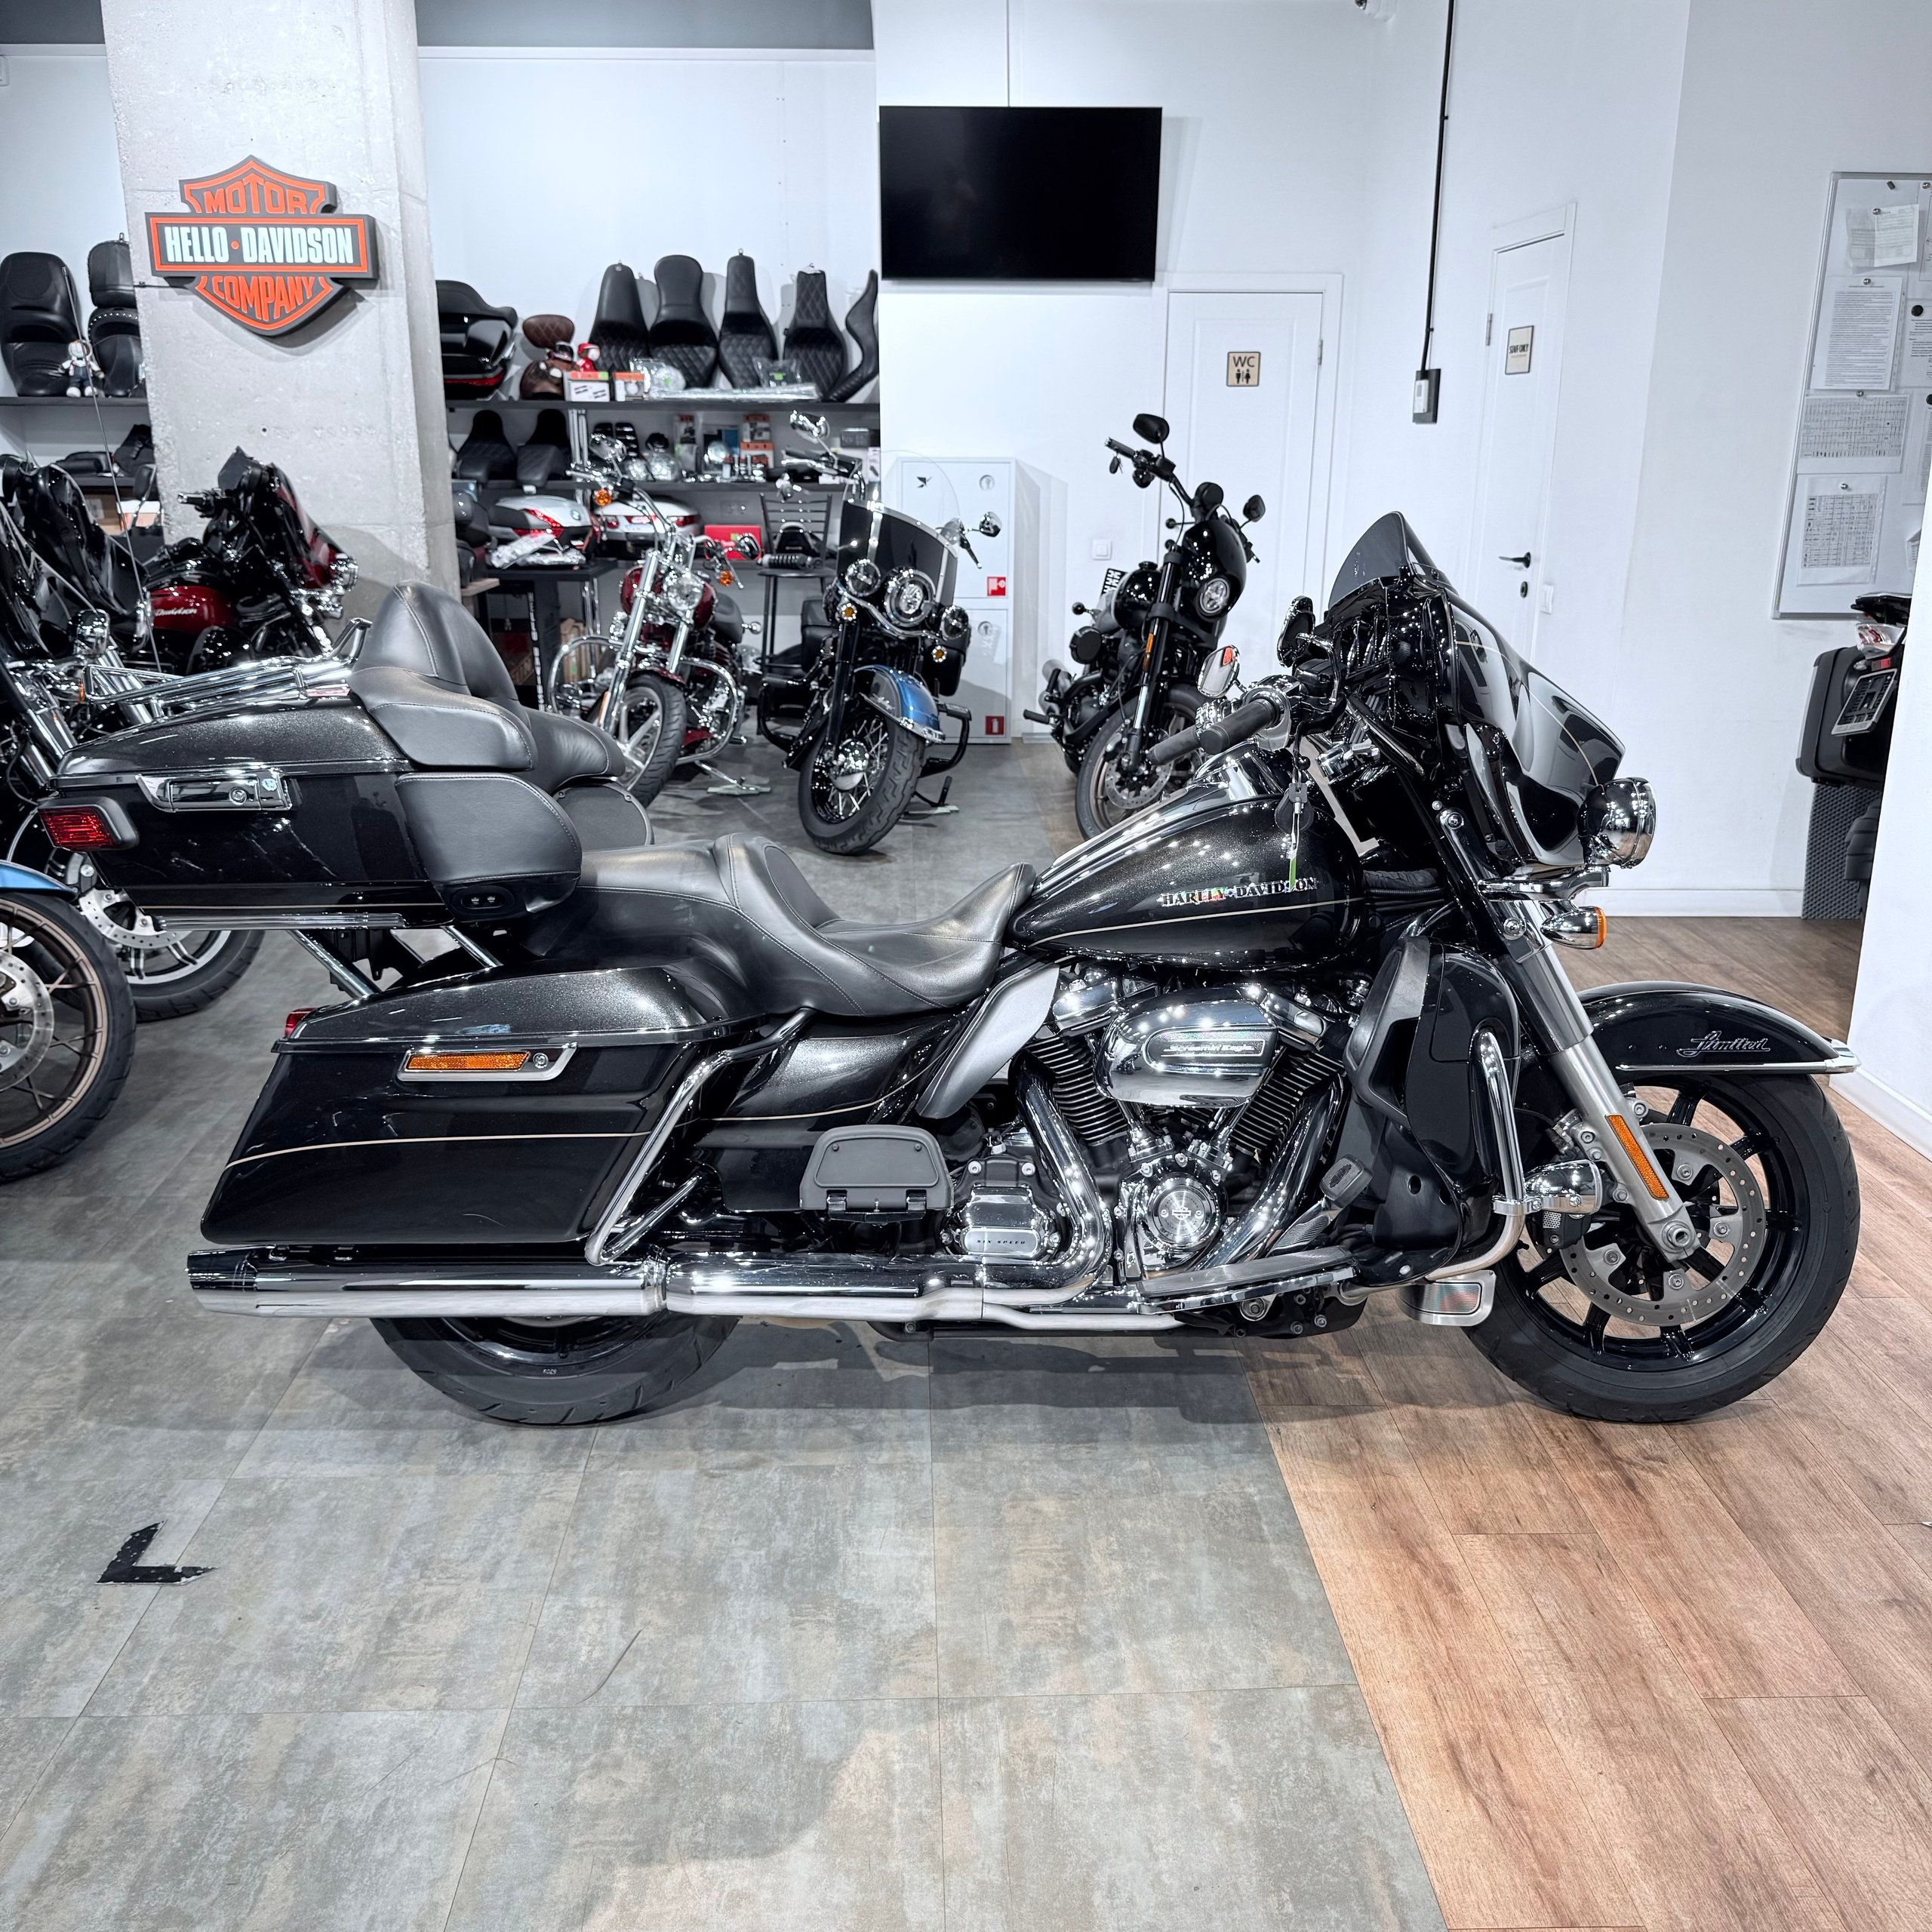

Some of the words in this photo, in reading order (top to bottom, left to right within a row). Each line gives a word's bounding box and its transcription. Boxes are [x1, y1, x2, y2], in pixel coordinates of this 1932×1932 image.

[204, 172, 307, 214] MOTOR
[164, 226, 229, 263] HELLO
[240, 226, 354, 263] DAVIDSON
[212, 275, 315, 321] COMPANY
[1232, 355, 1255, 368] WC
